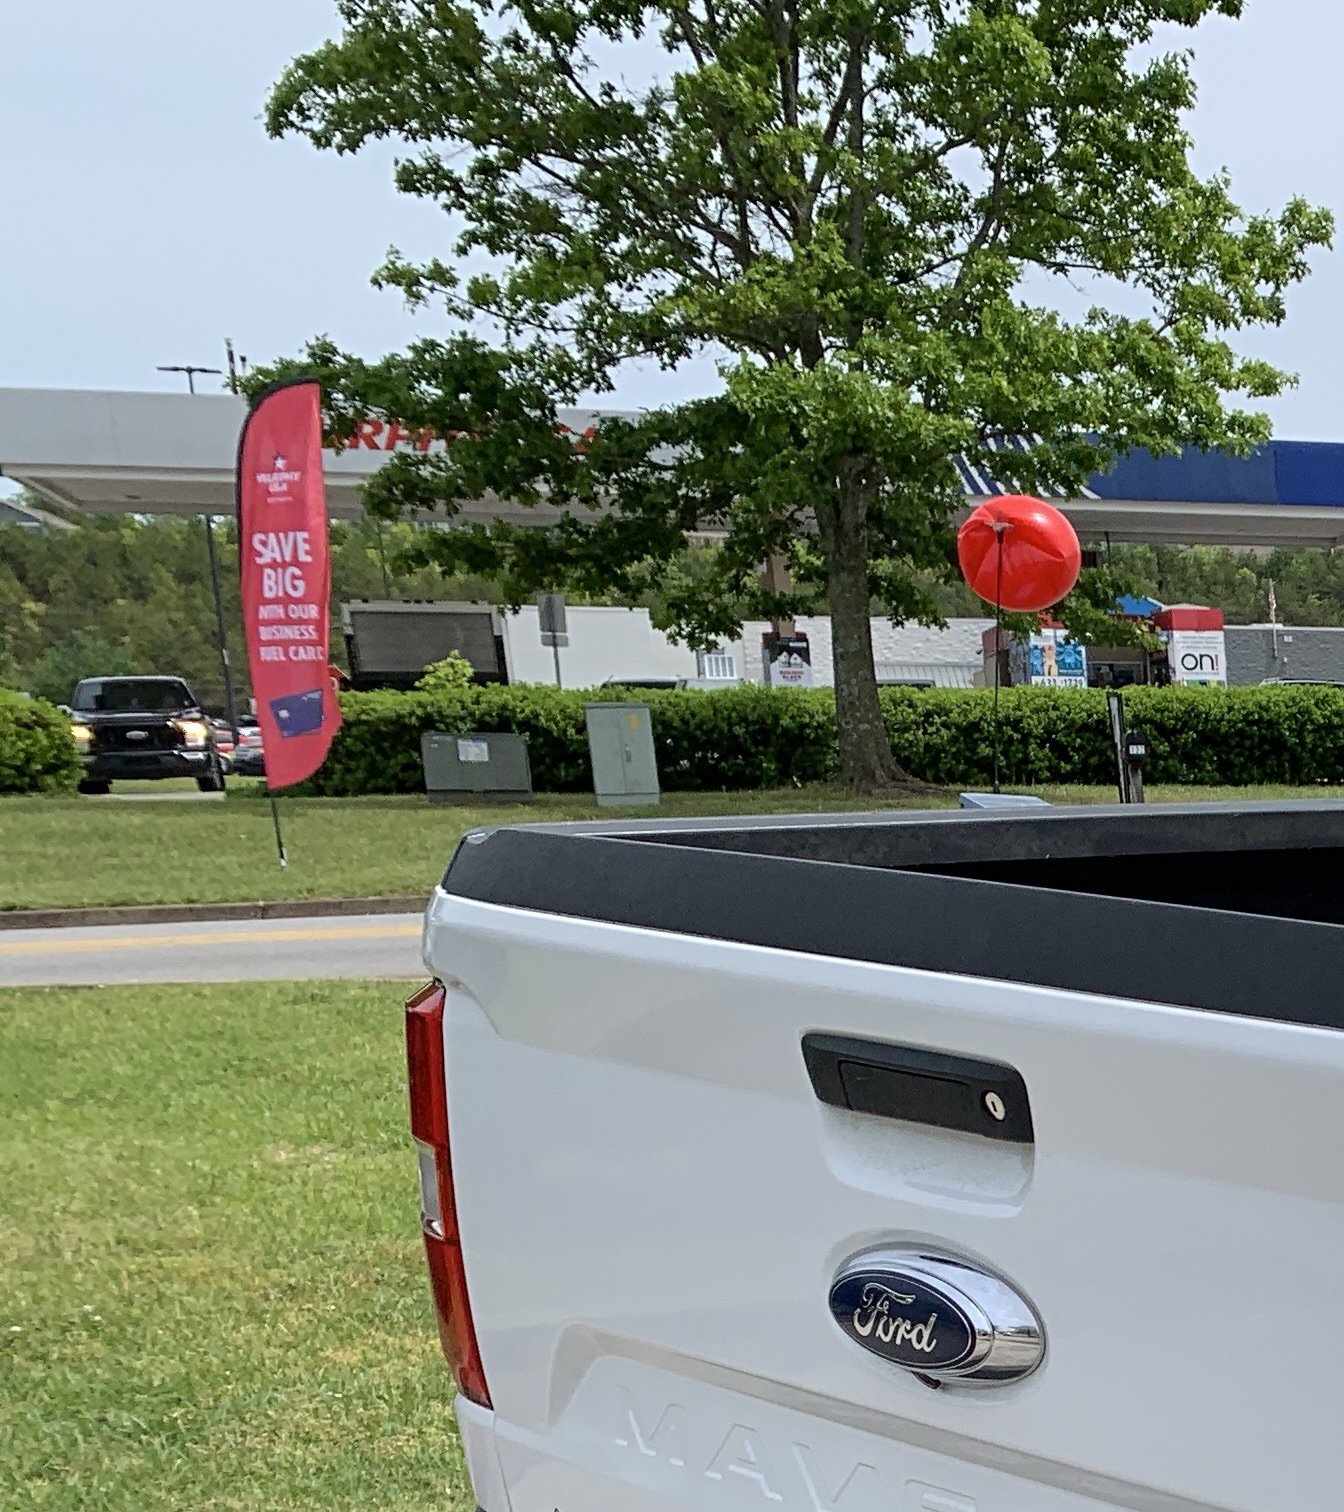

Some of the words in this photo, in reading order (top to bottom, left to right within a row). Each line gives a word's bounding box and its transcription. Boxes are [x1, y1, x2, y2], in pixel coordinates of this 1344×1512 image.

[252, 531, 313, 564] SAVE
[262, 566, 305, 598] BIG
[1181, 653, 1219, 671] on!
[853, 1283, 938, 1353] Ford
